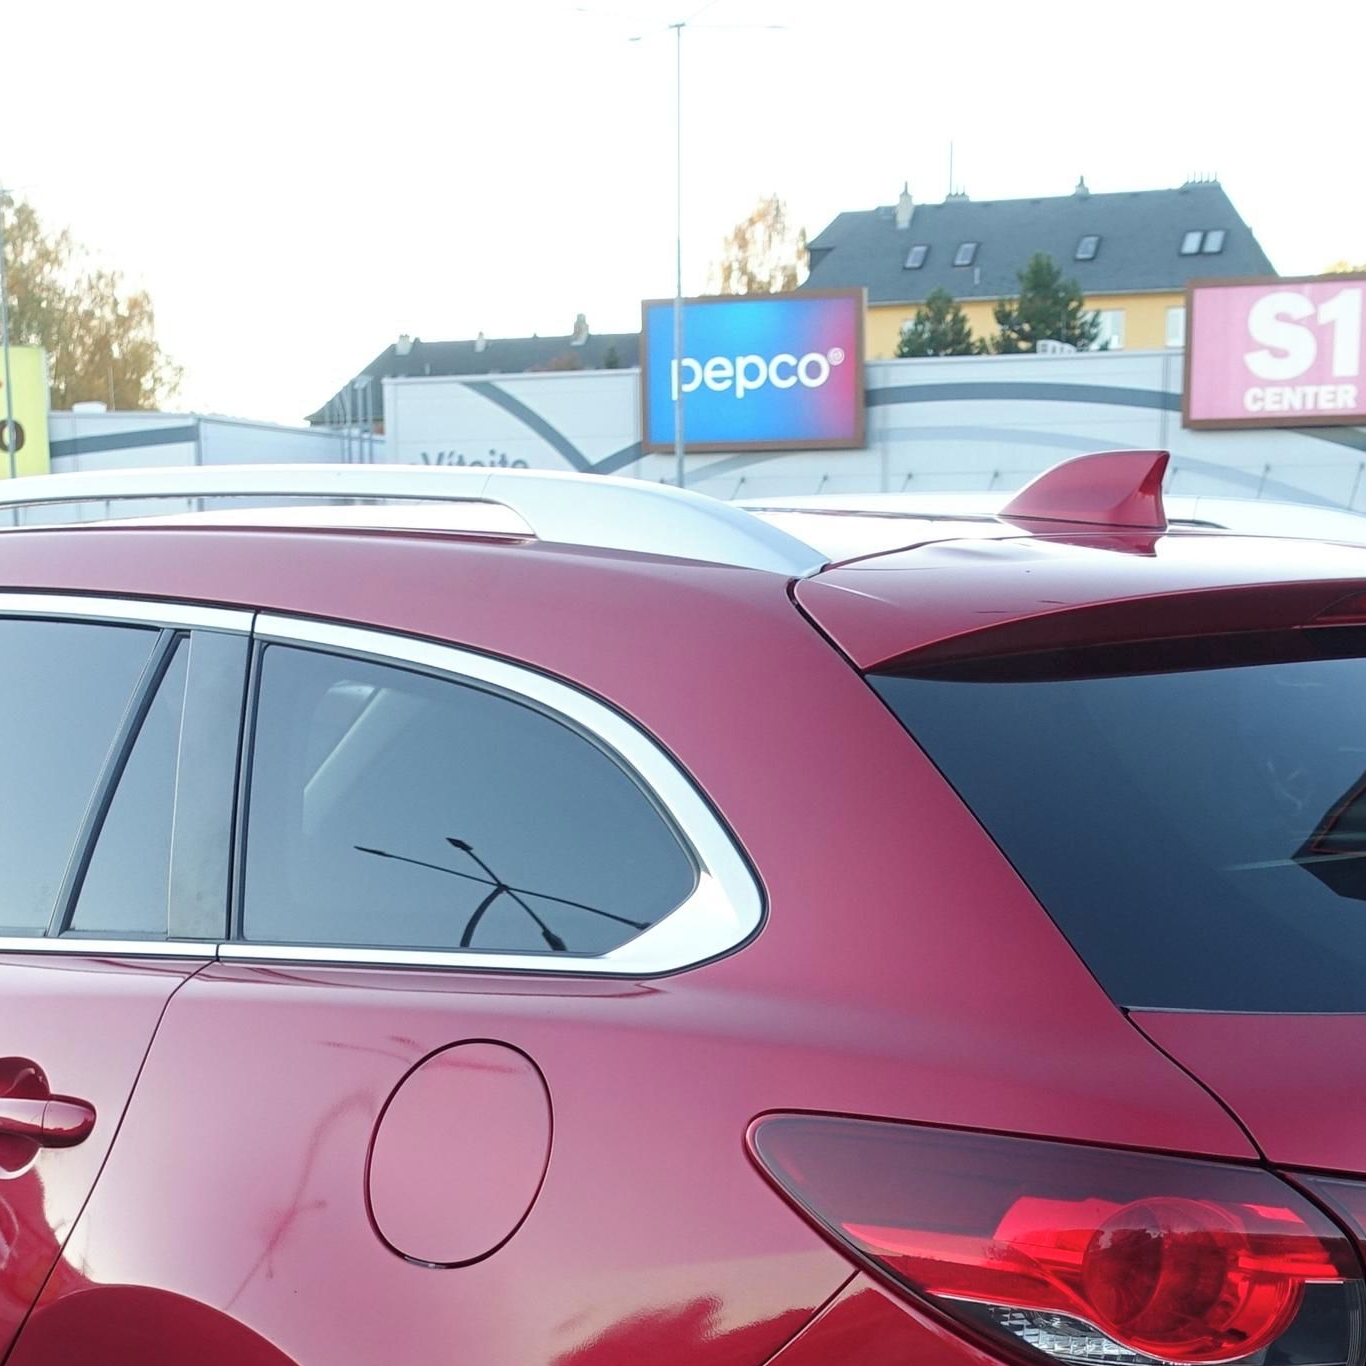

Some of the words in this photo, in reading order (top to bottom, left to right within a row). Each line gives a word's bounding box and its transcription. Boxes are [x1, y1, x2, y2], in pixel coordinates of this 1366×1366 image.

[1243, 288, 1362, 381] S1
[671, 352, 831, 401] pepco
[1244, 384, 1358, 413] CENTER
